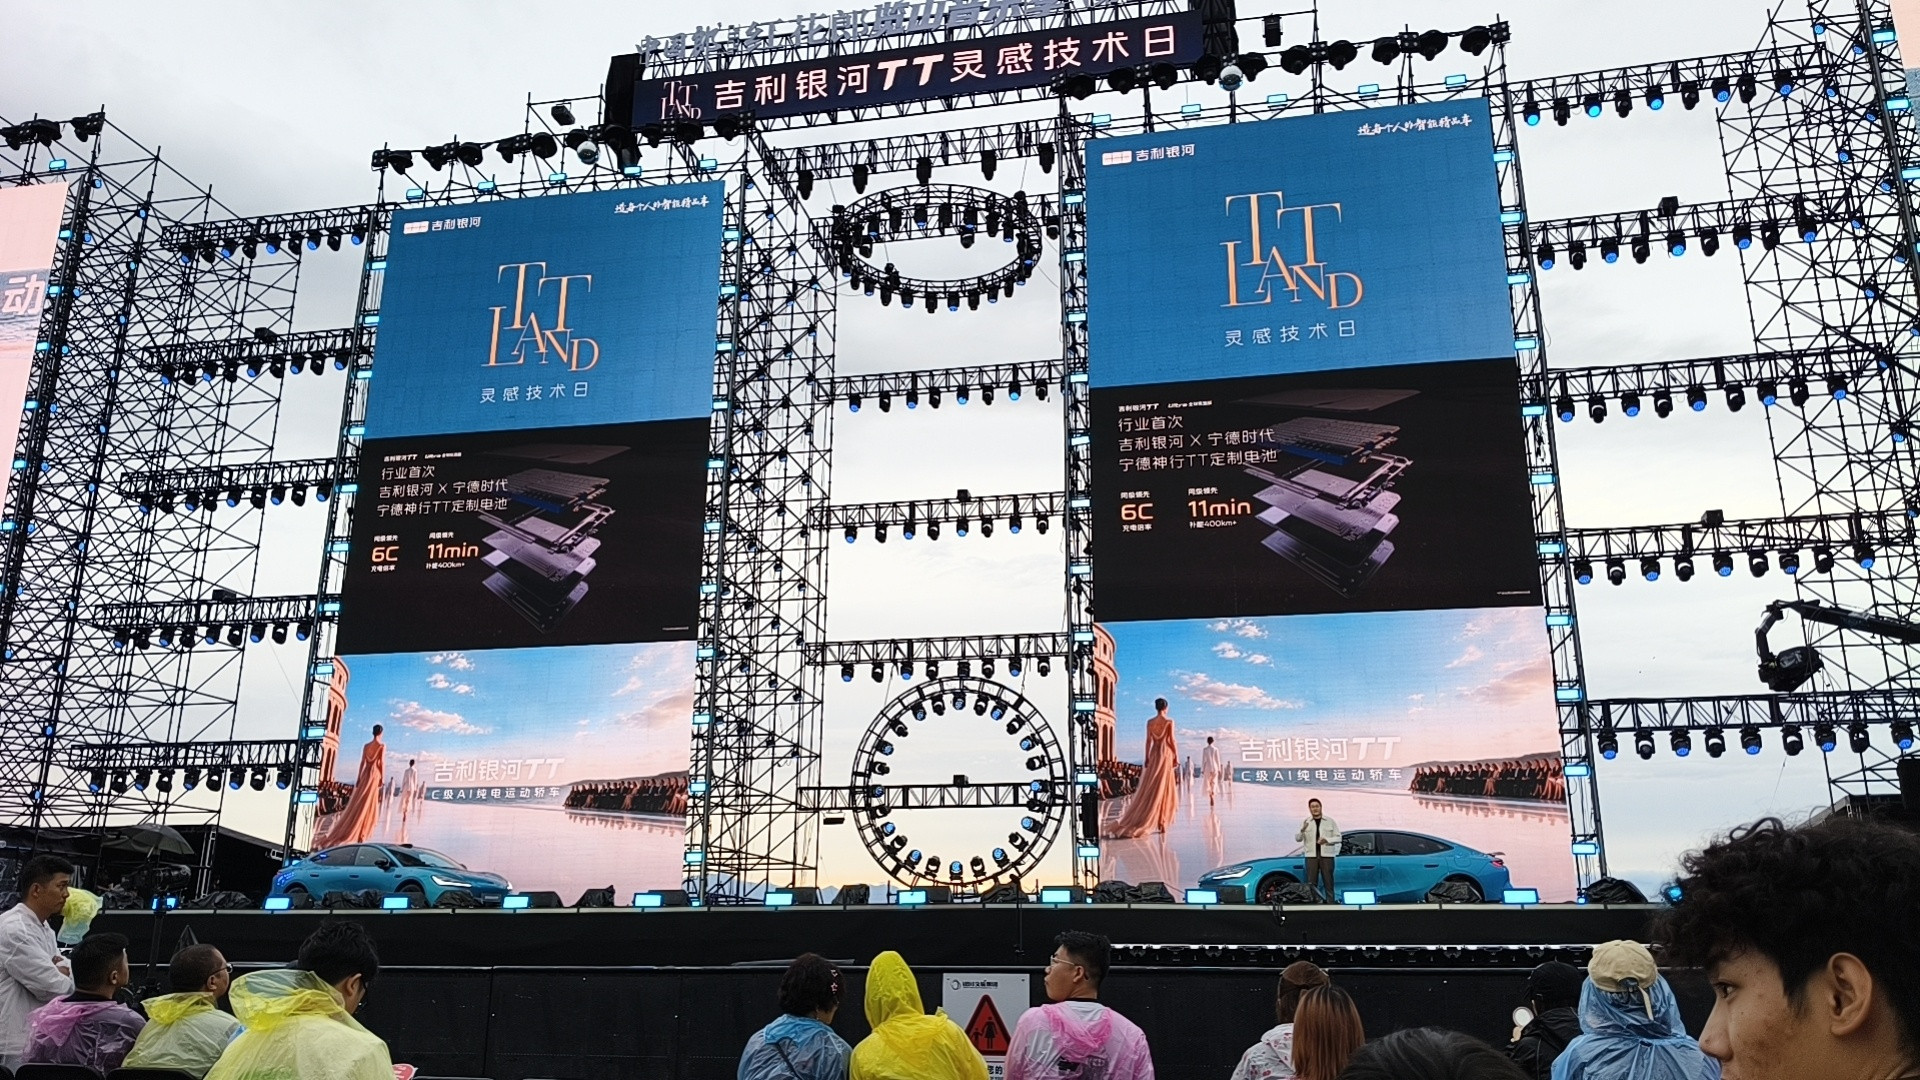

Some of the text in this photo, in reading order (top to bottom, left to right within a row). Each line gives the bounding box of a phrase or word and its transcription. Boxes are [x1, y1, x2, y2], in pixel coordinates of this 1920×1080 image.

[714, 26, 1176, 110] 吉利银河TT灵感技术日
[1135, 143, 1195, 162] 吉利银河
[431, 216, 482, 231] 吉利银河
[1225, 191, 1342, 266] TT
[1219, 241, 1364, 310] LAND
[2, 273, 46, 315] 动
[497, 262, 592, 332] TT
[481, 306, 600, 372] LAND
[1224, 320, 1357, 348] 灵感技术日
[480, 381, 589, 404] 灵感技术日
[1118, 415, 1183, 432] 行业首次
[1118, 434, 1184, 451] 吉利银河
[1207, 428, 1275, 446] 宁德时代
[1118, 449, 1278, 472] 宁德神行TT定制电池
[381, 465, 435, 480] 行业首次
[379, 482, 434, 498] 吉利银河
[452, 478, 509, 494] 宁德时代
[377, 497, 508, 517] 宁德神行TT定制电池
[1121, 503, 1154, 520] 6C
[1188, 498, 1251, 517] 11min
[371, 546, 399, 562] 6C
[427, 542, 479, 559] 11min
[1239, 736, 1401, 762] 吉利银河TT
[434, 758, 565, 782] 吉利银河TT
[1241, 768, 1402, 782] C级AI纯电运动轿车
[431, 786, 560, 800] C级AI纯电运动轿车
